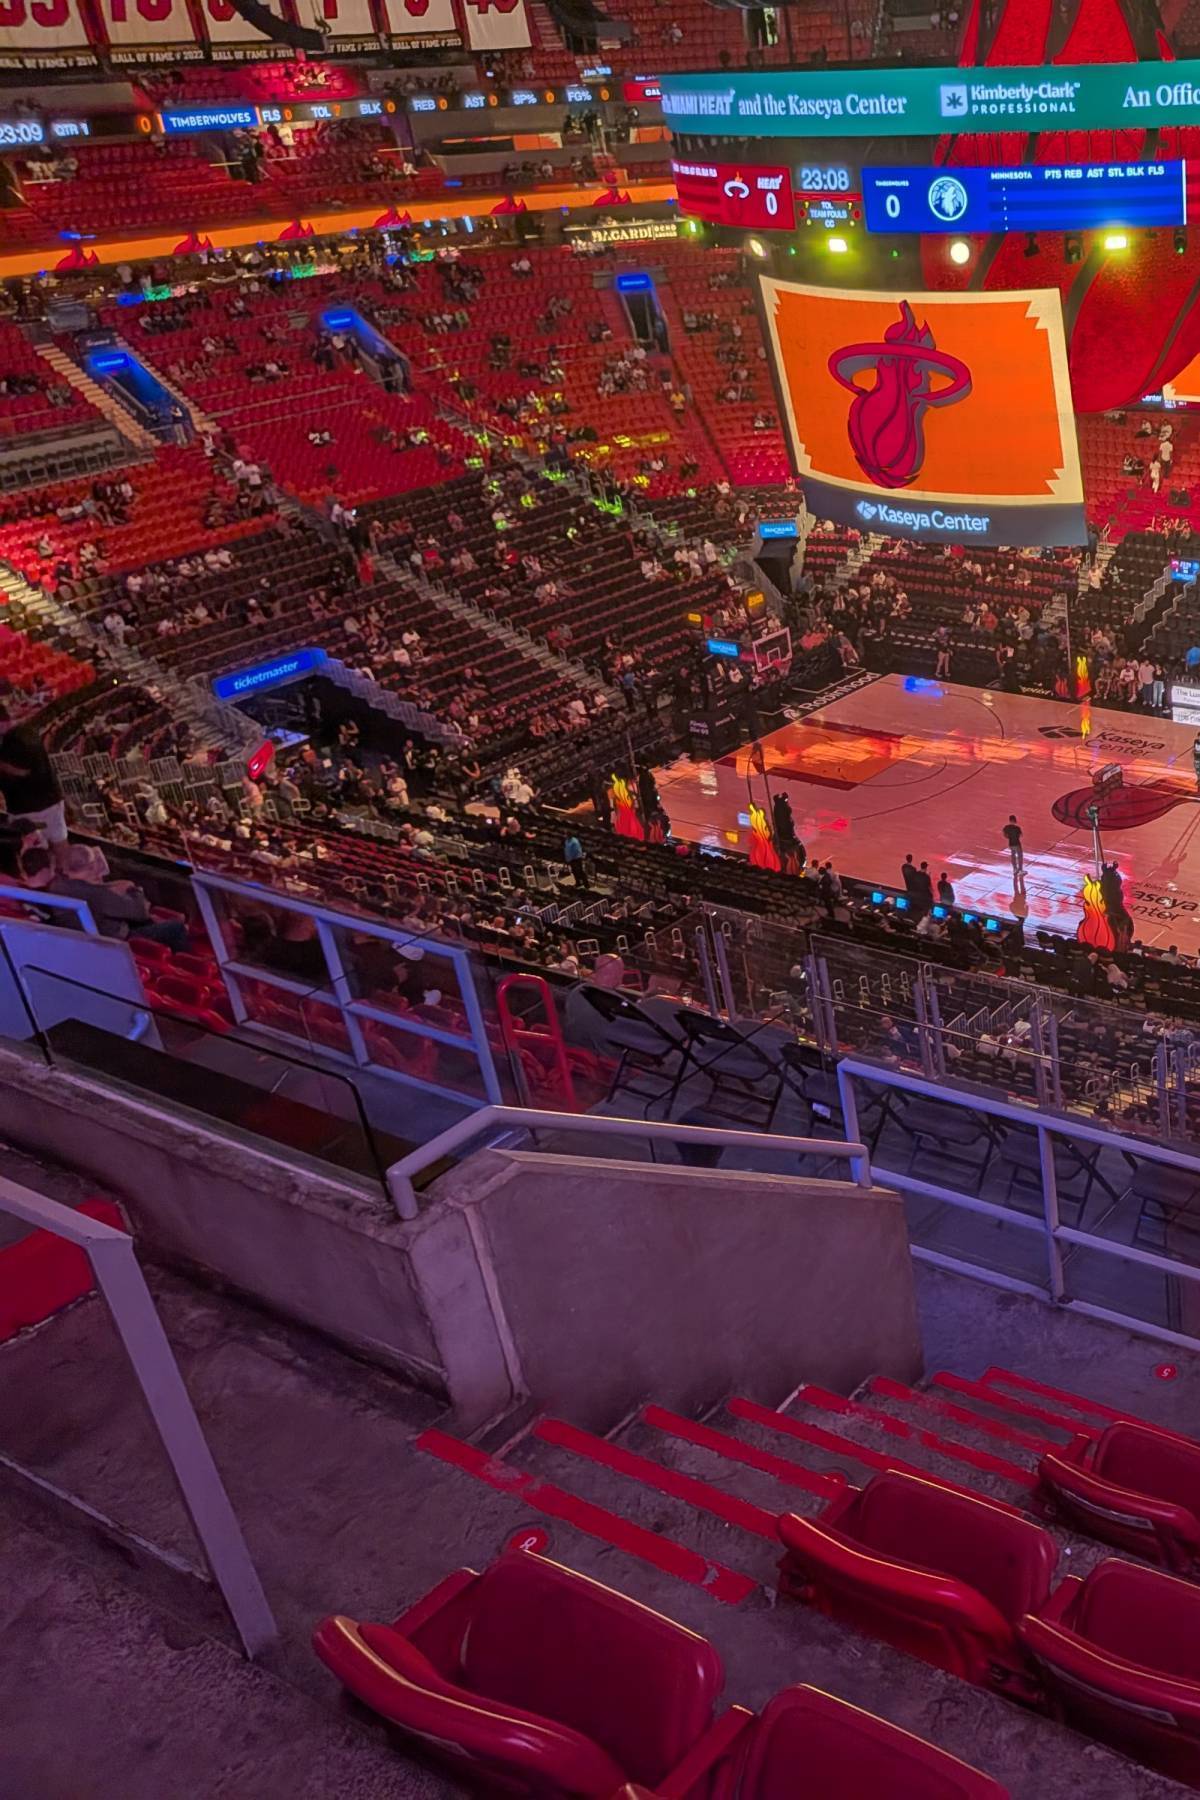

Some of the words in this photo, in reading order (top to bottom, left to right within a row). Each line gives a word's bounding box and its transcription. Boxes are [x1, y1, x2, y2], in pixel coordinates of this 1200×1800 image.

[392, 41, 411, 50] HALL
[421, 40, 440, 49] FAME
[111, 53, 136, 63] HALL
[149, 52, 174, 62] FAME
[212, 51, 234, 60] HALL
[246, 49, 269, 60] FAME
[0, 58, 23, 69] ALL
[465, 95, 485, 108] AST
[490, 95, 498, 106] 0
[545, 92, 555, 104] 0
[567, 90, 592, 102] FG%
[601, 89, 609, 101] 0
[1122, 86, 1151, 108] An
[360, 102, 382, 115] BLK
[387, 101, 396, 113] 0
[413, 100, 435, 111] REB
[440, 99, 448, 110] 0
[700, 88, 736, 115] HEAT
[739, 93, 762, 115] and
[764, 94, 786, 115] the
[788, 94, 843, 119] Kaseya
[845, 94, 907, 115] Center
[972, 102, 1076, 114] PROFESSIONAL
[262, 109, 281, 121] FLS
[284, 108, 292, 120] 0
[311, 106, 331, 118] TOL
[52, 122, 79, 136] QTR
[141, 116, 151, 133] 0
[169, 112, 251, 128] TIMBERWOLVES
[802, 169, 849, 190] 23:08
[991, 171, 1032, 180] MINNESOTA
[1045, 169, 1062, 179] PTS
[1064, 169, 1082, 179] REB
[1087, 168, 1104, 178] AST
[1108, 167, 1124, 177] STL
[1127, 166, 1144, 176] BLK
[1148, 166, 1164, 175] FLS
[757, 175, 782, 190] HEAT
[766, 192, 777, 215] 0
[886, 194, 900, 218] 0
[878, 504, 930, 531] Kaseya
[931, 511, 989, 531] Center
[234, 661, 298, 690] ticketmaster
[799, 671, 882, 711] Robinhood
[1095, 731, 1165, 750] Kaseya
[1085, 740, 1153, 757] Center
[1134, 890, 1199, 911] aseya
